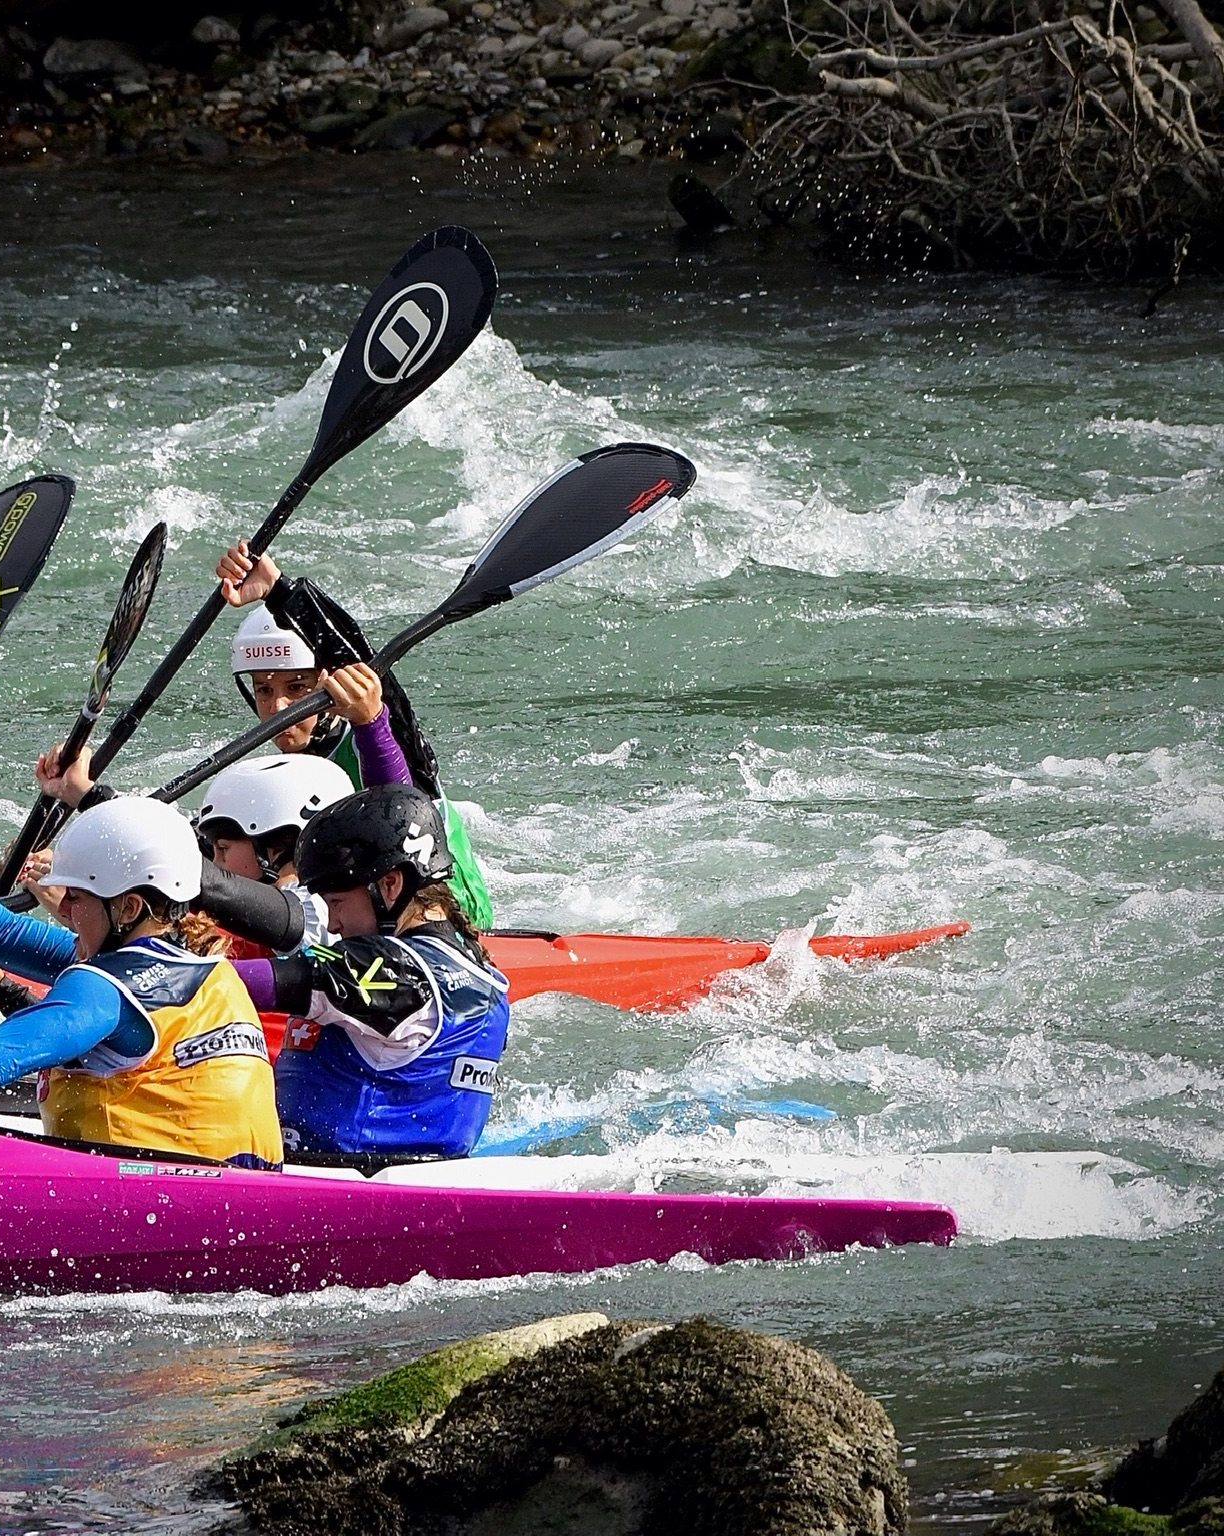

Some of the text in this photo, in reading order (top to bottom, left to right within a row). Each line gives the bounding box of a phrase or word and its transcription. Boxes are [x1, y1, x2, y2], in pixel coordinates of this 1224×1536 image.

[245, 645, 291, 659] SUISSE
[132, 962, 165, 985] SWISS
[139, 967, 172, 992] CANOE
[443, 969, 470, 982] SWISS
[447, 976, 475, 992] CANOE
